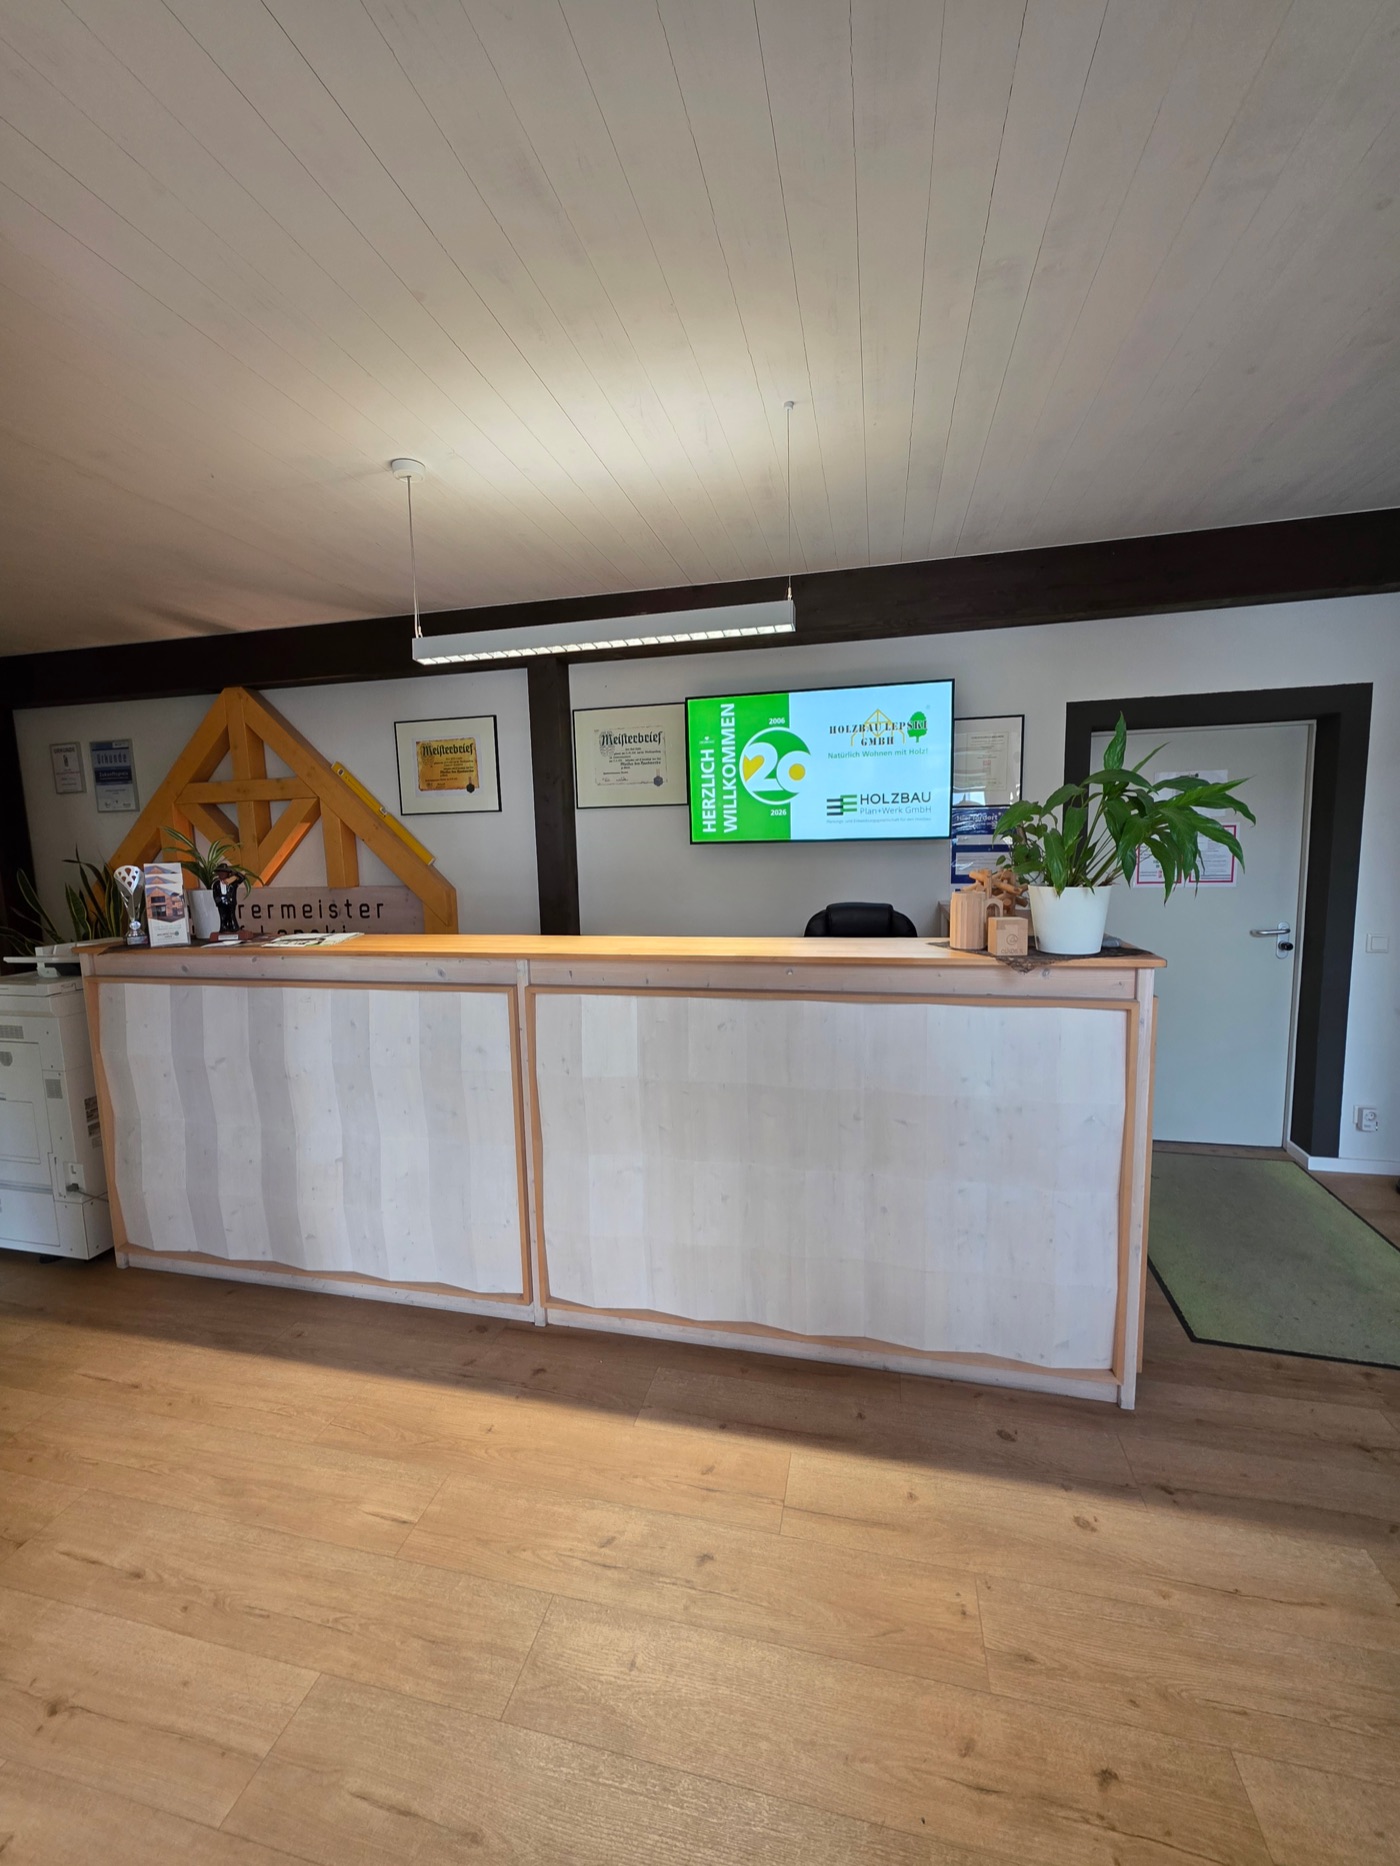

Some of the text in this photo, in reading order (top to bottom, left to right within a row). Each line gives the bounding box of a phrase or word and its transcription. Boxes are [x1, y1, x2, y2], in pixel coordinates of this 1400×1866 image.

[829, 720, 928, 735] HOLZBAU LEPSKI
[601, 731, 662, 746] Meisterbrief
[860, 736, 894, 746] GMBH
[422, 743, 473, 756] Meisterbrief
[827, 751, 860, 759] Natürlich
[862, 750, 892, 758] Wohnen
[908, 747, 929, 756] Holz!
[720, 703, 738, 832] WILLKOMMEN
[700, 749, 717, 833] HERZLICH
[860, 792, 931, 805] HOLZBAU
[860, 805, 932, 815] Plan+Werk GmbH
[238, 899, 384, 919] rermeister
